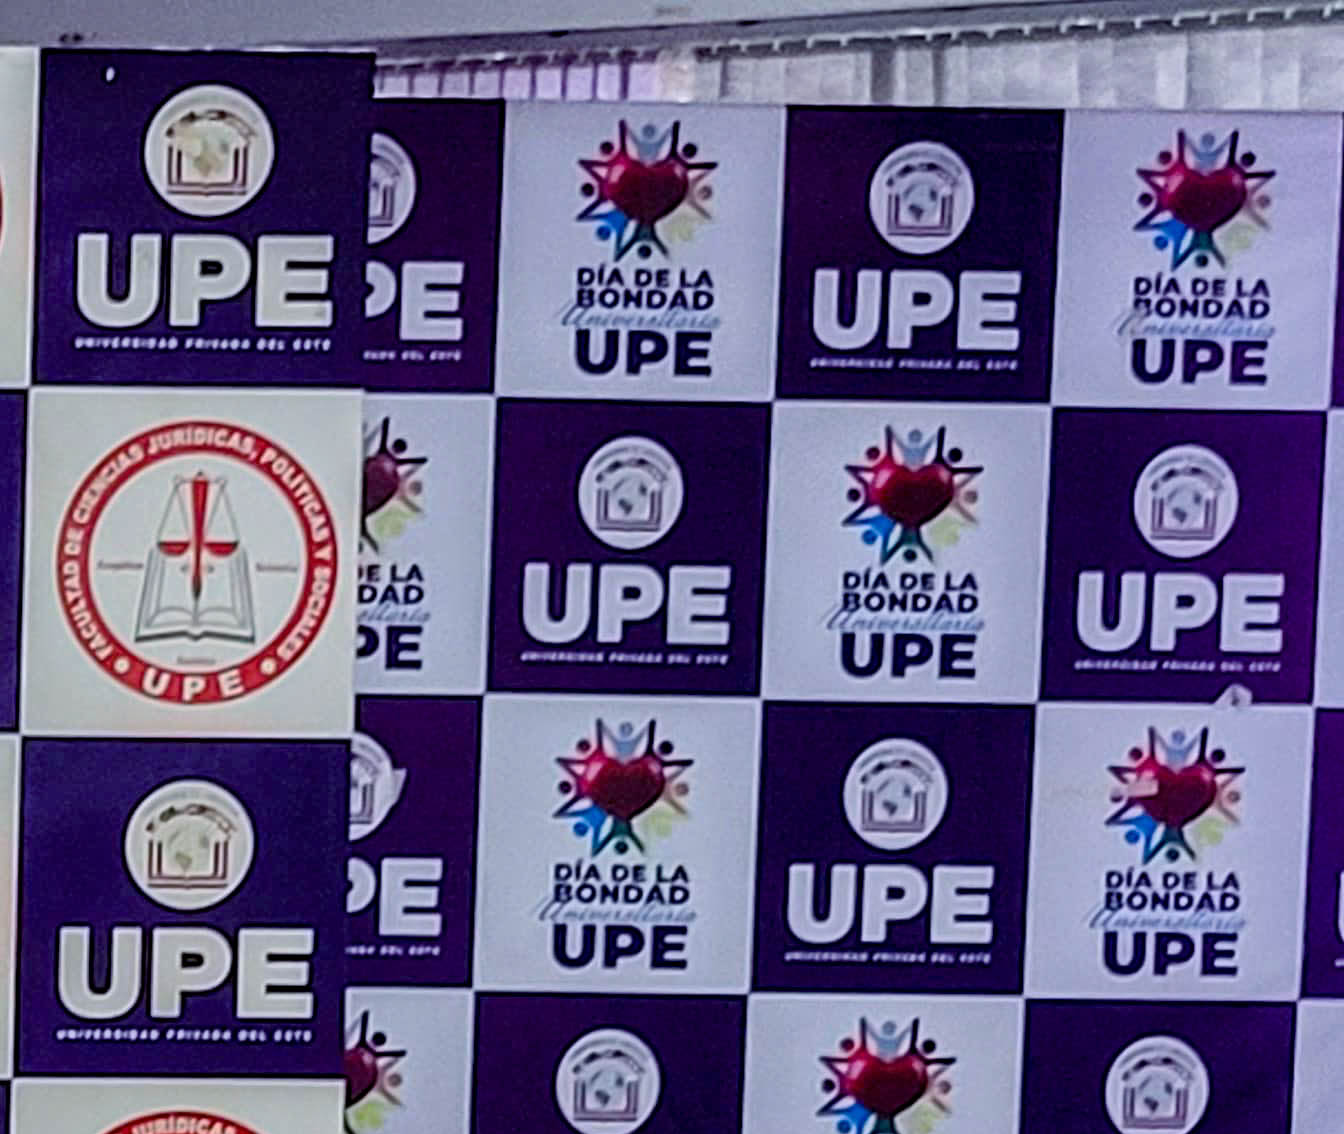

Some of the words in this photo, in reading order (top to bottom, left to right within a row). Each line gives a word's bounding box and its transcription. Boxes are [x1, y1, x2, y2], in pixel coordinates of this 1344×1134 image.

[78, 234, 332, 326] UPE
[577, 264, 624, 288] DÍA
[635, 269, 669, 290] DE
[680, 269, 713, 289] LA
[577, 288, 714, 310] BONDAD
[1134, 272, 1180, 298] DÍA
[1192, 278, 1226, 298] DE
[1237, 279, 1269, 298] LA
[814, 270, 1020, 349] UPE
[1134, 297, 1270, 319] BONDAD
[575, 330, 712, 377] UPE
[1132, 338, 1268, 385] UPE
[843, 568, 889, 592] DÍA
[901, 573, 934, 591] DE
[945, 573, 978, 592] LA
[524, 564, 730, 644] UPE
[840, 592, 978, 613] BONDAD
[1078, 573, 1284, 651] UPE
[841, 633, 976, 678] UPE
[553, 882, 689, 905] BONDAD
[555, 860, 600, 883] DÍA
[612, 864, 645, 883] DE
[656, 865, 688, 883] LA
[1106, 868, 1151, 891] DÍA
[1163, 872, 1196, 891] DE
[1207, 872, 1239, 891] LA
[789, 865, 993, 943] UPE
[1104, 891, 1240, 912] BONDAD
[553, 924, 688, 970] UPE
[1104, 932, 1238, 976] UPE
[60, 928, 313, 1018] UPE
